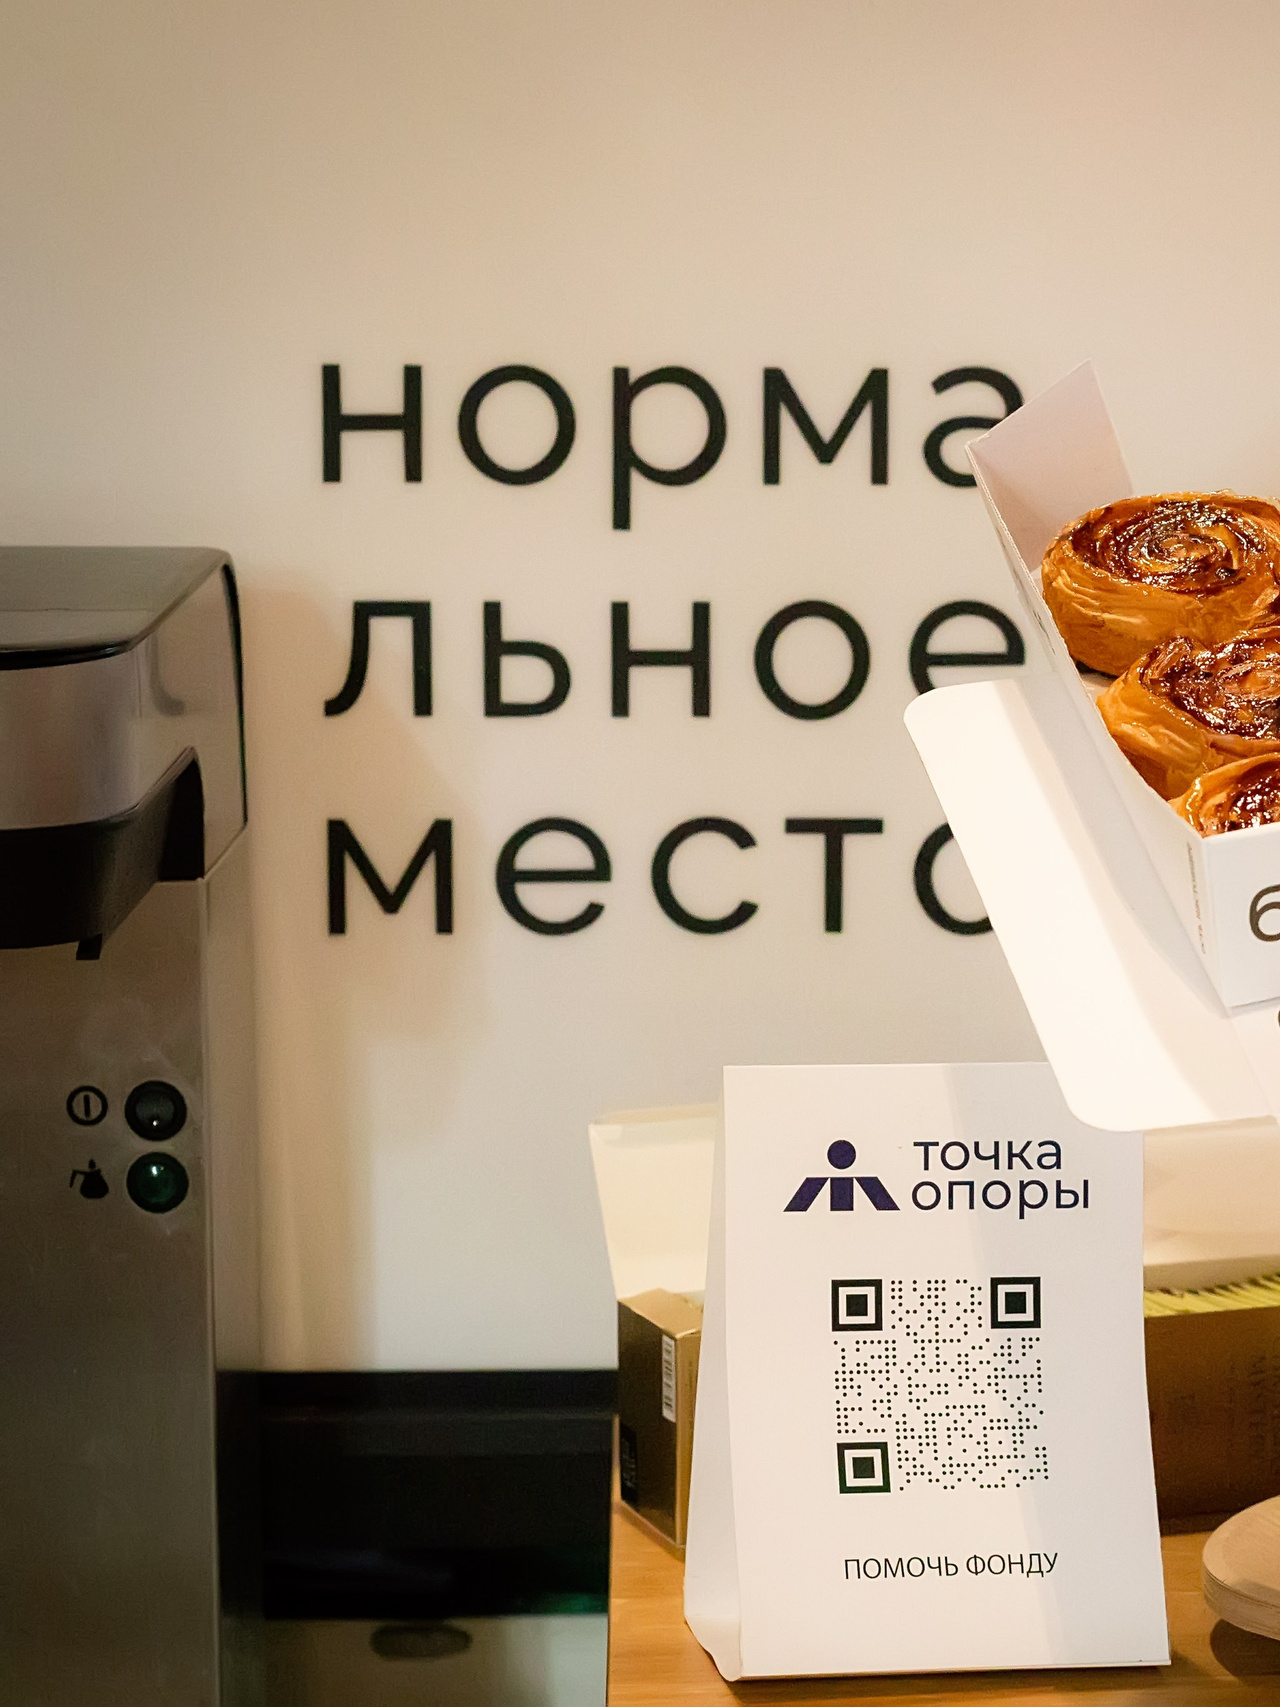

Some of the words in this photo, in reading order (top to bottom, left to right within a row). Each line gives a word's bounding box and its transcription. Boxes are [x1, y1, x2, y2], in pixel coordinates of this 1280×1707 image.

[321, 363, 1025, 531] норма
[323, 599, 1027, 721] льное
[913, 1139, 1063, 1172] точка
[911, 1178, 1091, 1220] опоры
[843, 1556, 960, 1581] ПОМОЧЬ
[965, 1552, 1060, 1579] ФОНДУ
